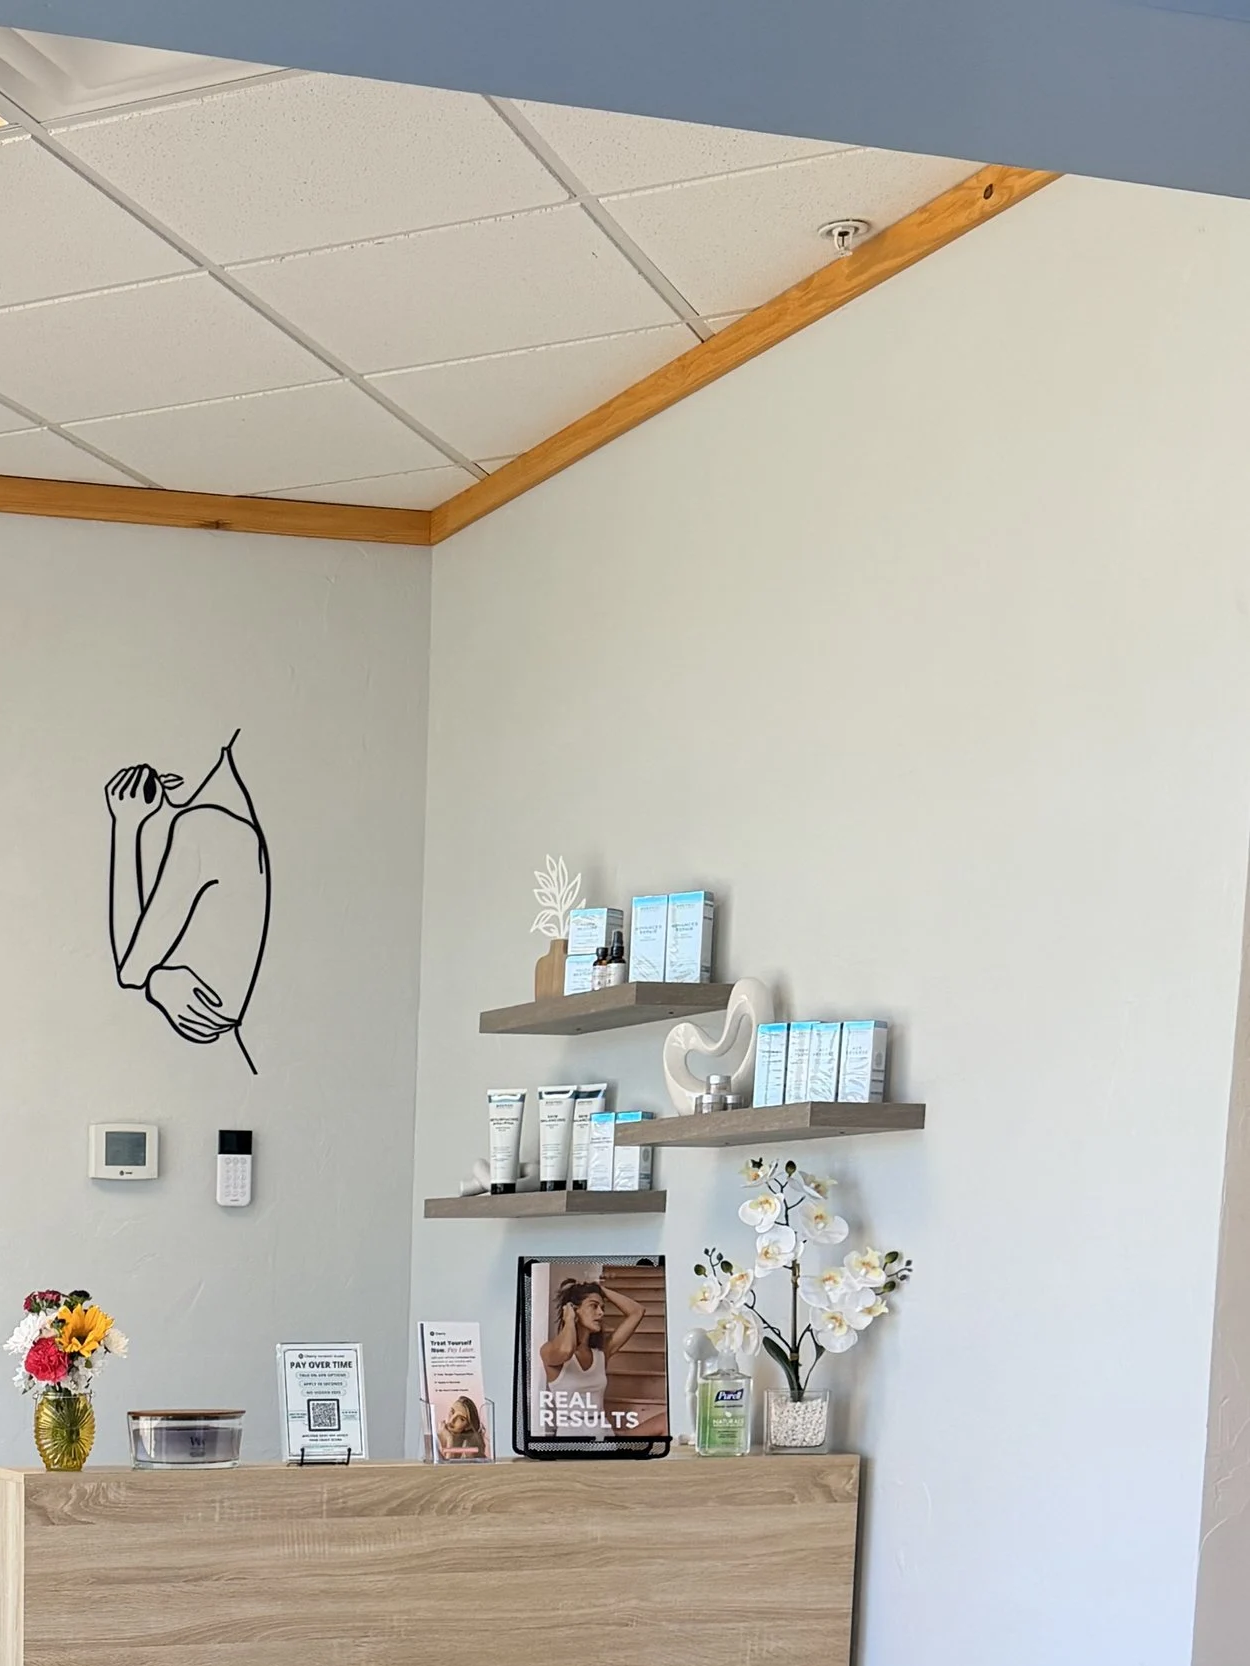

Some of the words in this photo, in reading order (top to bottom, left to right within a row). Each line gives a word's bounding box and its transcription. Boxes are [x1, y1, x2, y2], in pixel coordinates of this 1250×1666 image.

[290, 1361, 307, 1369] PAY
[309, 1361, 331, 1369] OVER
[332, 1361, 353, 1369] TIME
[539, 1391, 598, 1409] REAL
[539, 1410, 640, 1429] RESULTS
